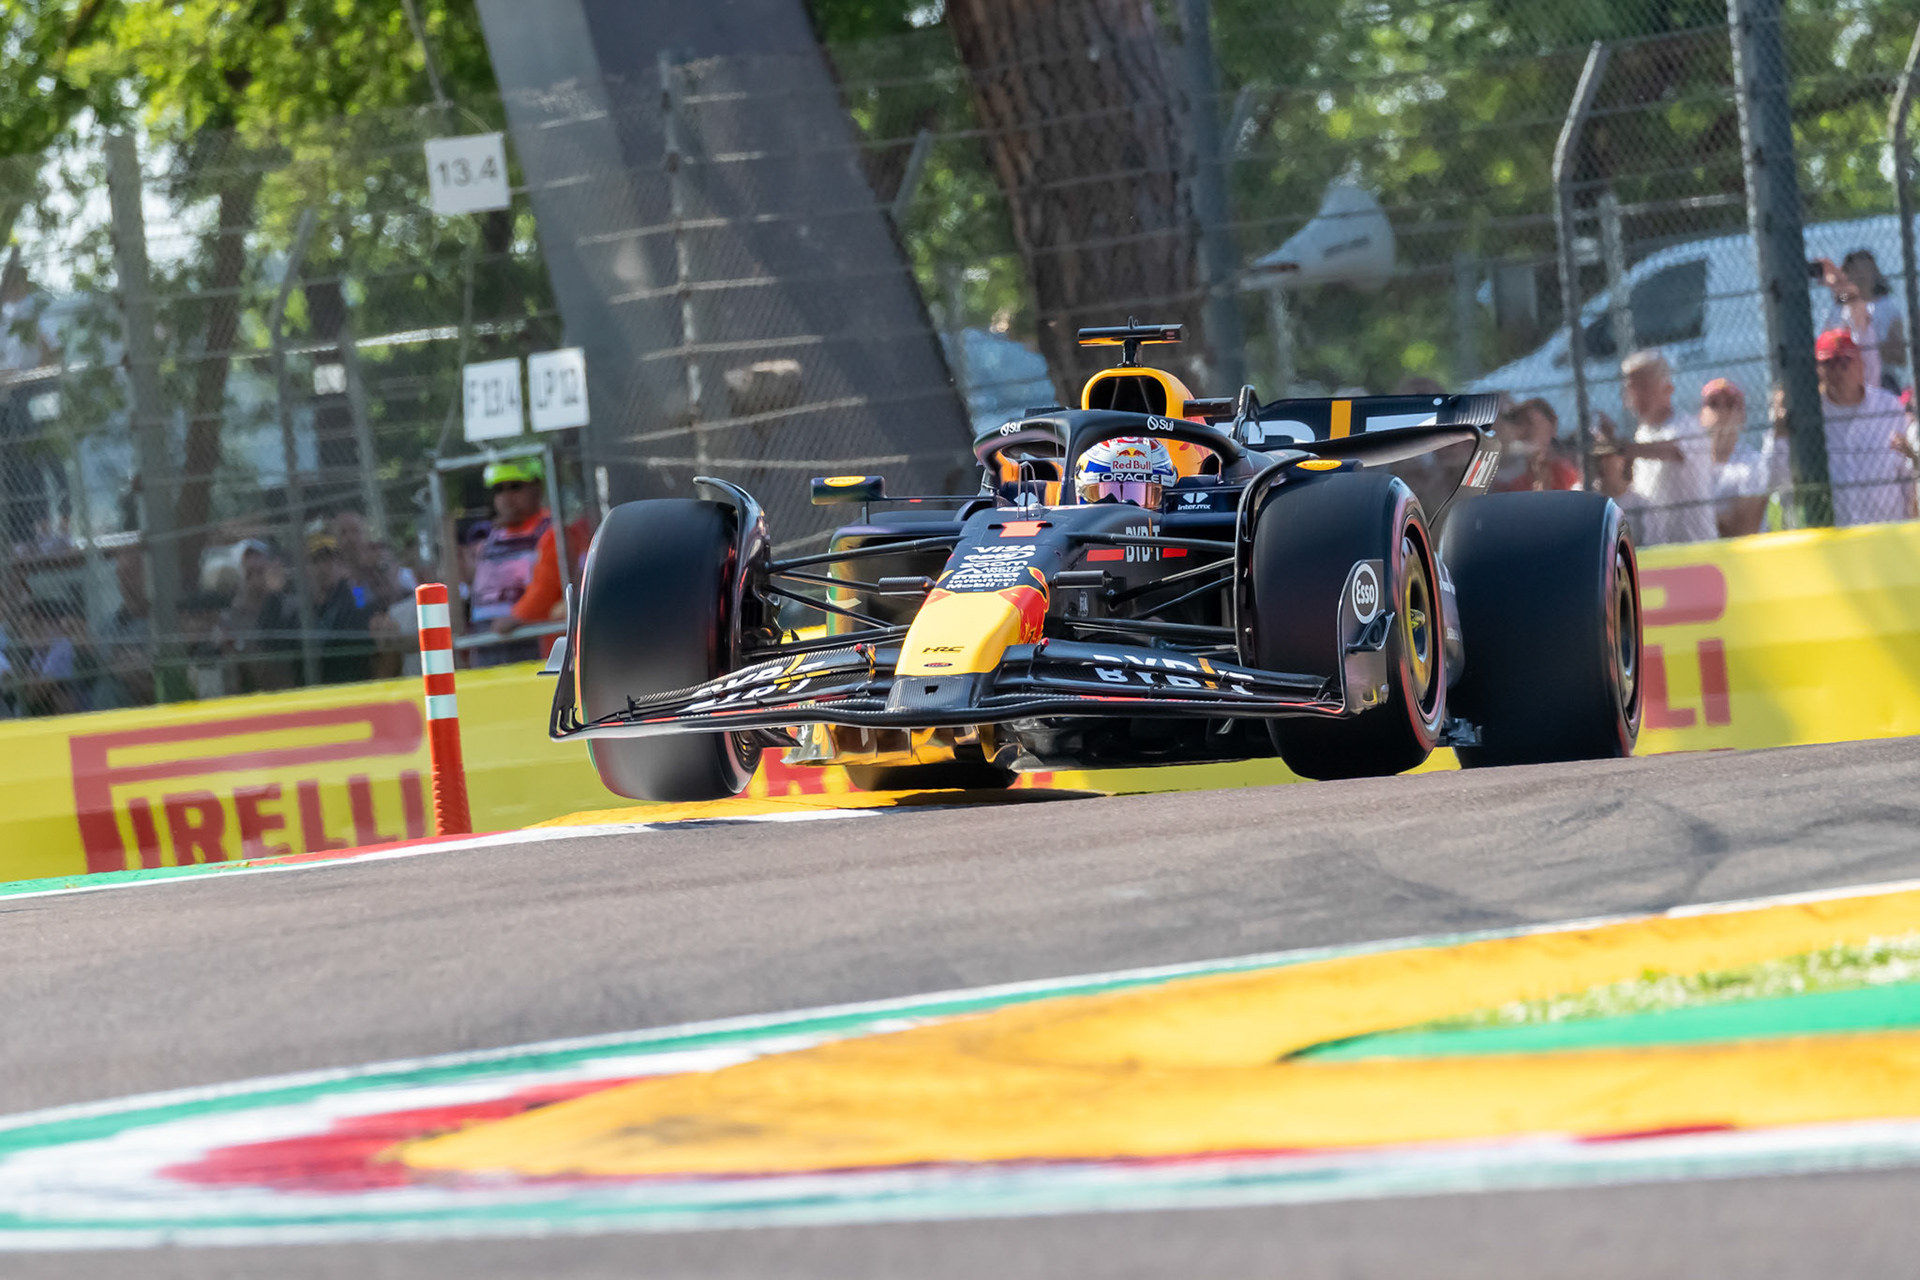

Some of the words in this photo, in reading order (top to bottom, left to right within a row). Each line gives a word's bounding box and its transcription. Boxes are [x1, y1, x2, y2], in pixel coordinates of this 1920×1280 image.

[435, 153, 498, 187] 13.4
[1159, 420, 1174, 432] Sui
[1112, 461, 1131, 470] Red
[1133, 461, 1151, 470] Bull
[1101, 472, 1160, 483] ORACLE
[972, 545, 1036, 553] VISA
[1356, 579, 1374, 605] Esso
[69, 699, 428, 875] PIRELLI
